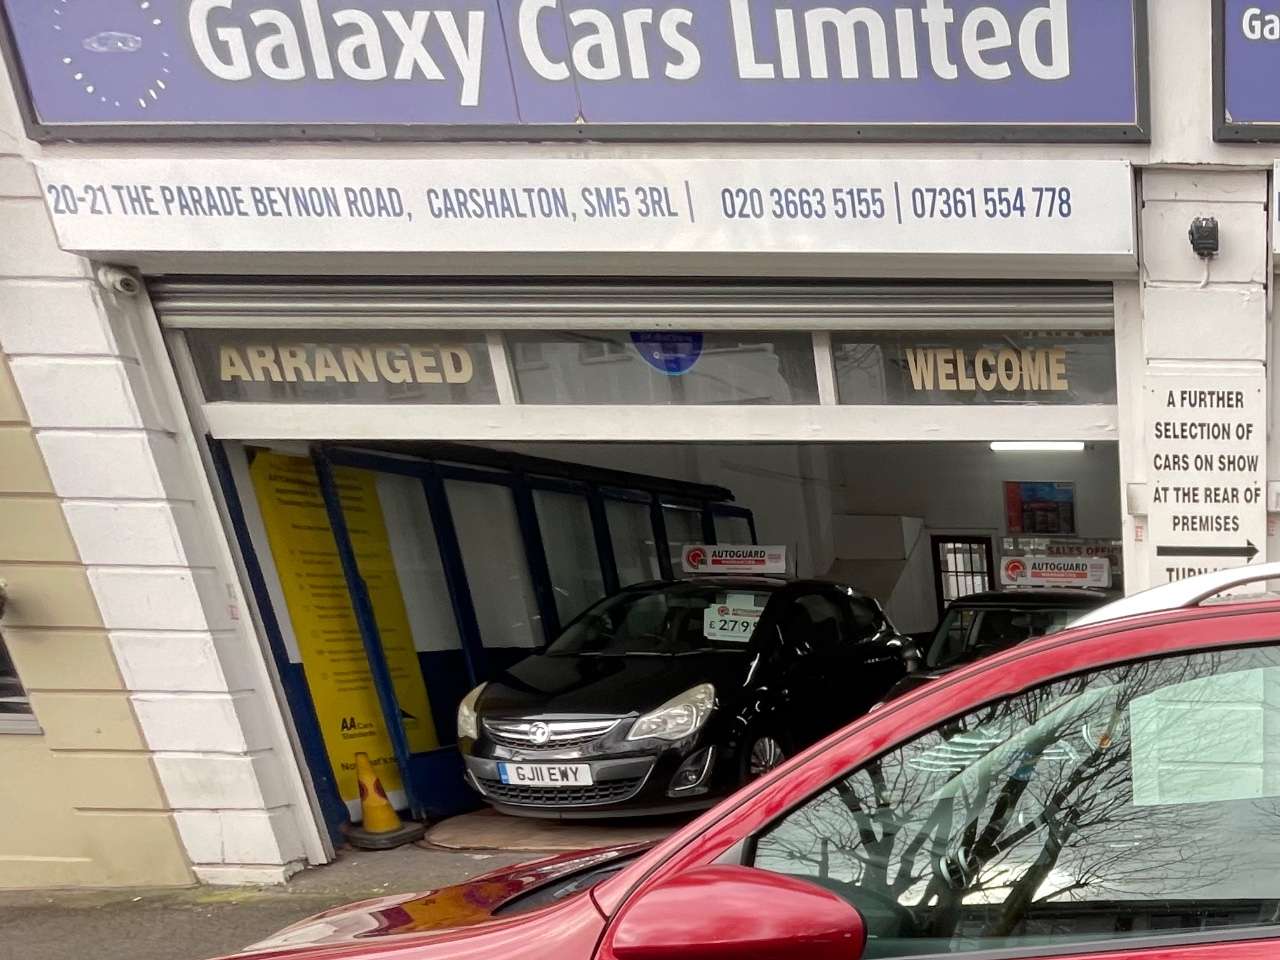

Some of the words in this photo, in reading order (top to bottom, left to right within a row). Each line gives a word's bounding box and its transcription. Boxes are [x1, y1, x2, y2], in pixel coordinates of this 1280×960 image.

[188, 0, 485, 106] Galaxy
[518, 0, 701, 80] Cars
[729, 0, 1070, 80] Limited
[47, 184, 112, 216] 20-21
[112, 184, 160, 217] THE
[160, 185, 249, 218] PARADE
[251, 186, 341, 218] BEYNON
[344, 186, 413, 222] ROAD,
[582, 187, 631, 218] SM5
[635, 187, 679, 218] 3RL
[720, 187, 765, 220] 020
[770, 187, 830, 220] 3663
[833, 187, 885, 219] 5155
[911, 187, 977, 219] 07361
[983, 187, 1026, 219] 554
[1031, 187, 1072, 219] 778
[219, 344, 474, 385] ARRANGED
[905, 347, 1070, 391] WELCOME
[1166, 390, 1176, 408] A
[1180, 390, 1245, 409] FURTHER
[1154, 422, 1231, 440] SELECTION
[1235, 423, 1254, 441] OF
[1153, 453, 1190, 471] CARS
[1194, 454, 1214, 472] ON
[1218, 455, 1259, 472] SHOW
[1153, 487, 1170, 503] AT
[1173, 487, 1200, 504] THE
[1204, 488, 1240, 504] REAR
[1244, 487, 1262, 504] OF
[1172, 515, 1240, 532] PREMISES
[711, 549, 766, 559] AUTOGUARD
[1031, 562, 1088, 572] AUTOGUARD
[341, 717, 357, 731] AA
[547, 766, 579, 782] EWY
